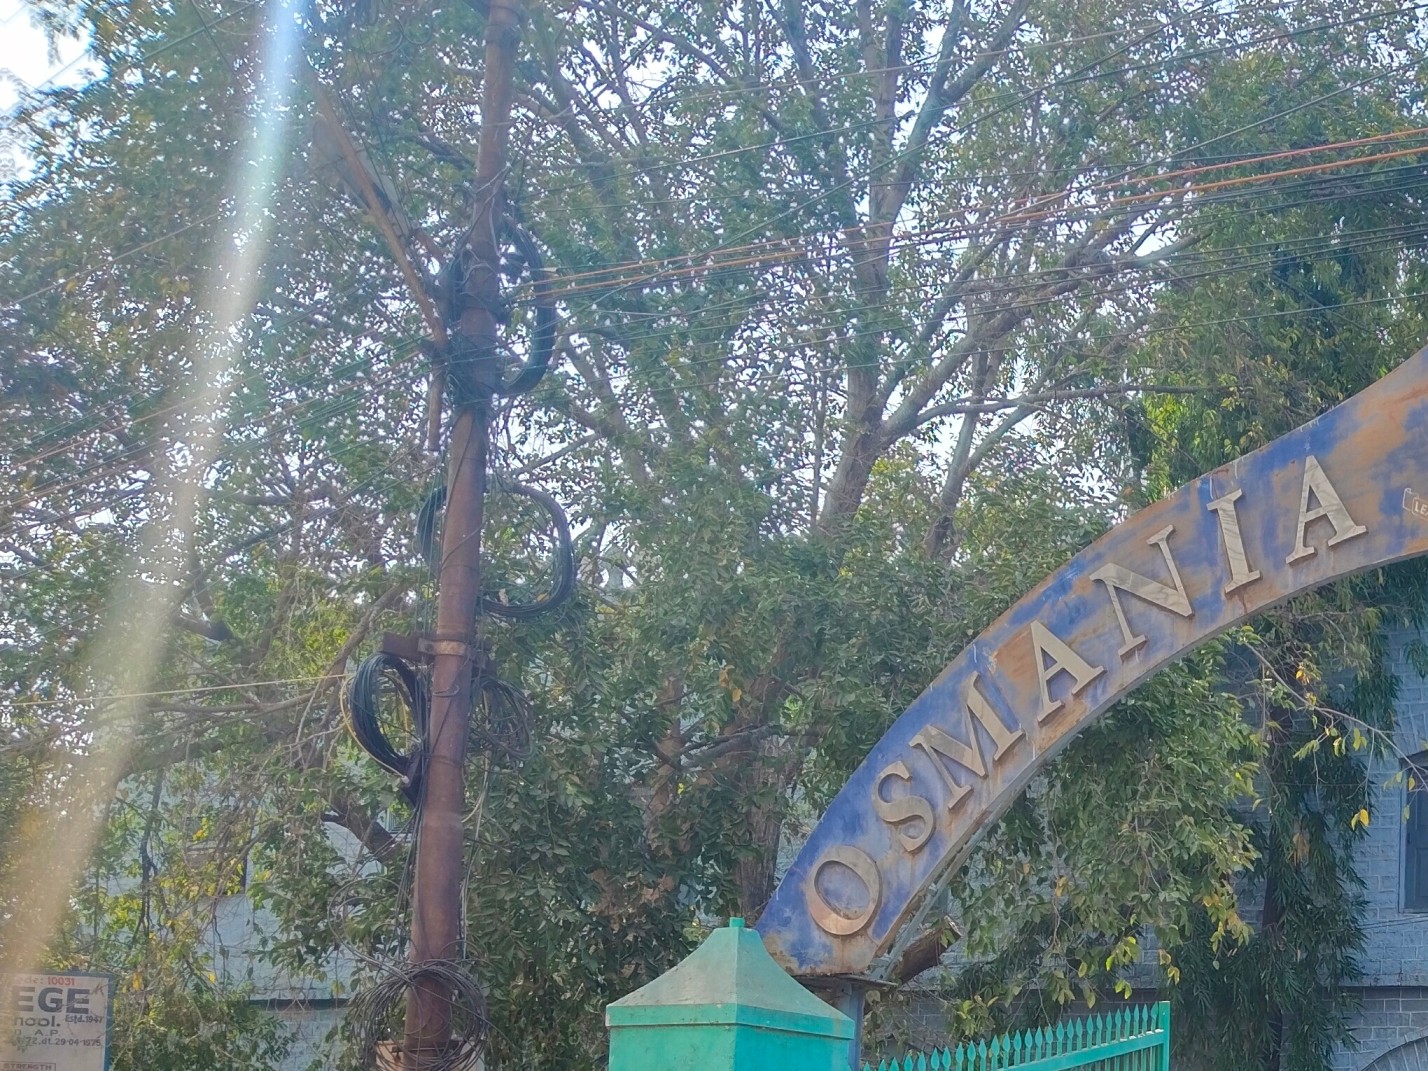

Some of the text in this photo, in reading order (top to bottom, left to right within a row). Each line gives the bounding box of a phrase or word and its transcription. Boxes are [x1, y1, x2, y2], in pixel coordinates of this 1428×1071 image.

[808, 455, 1367, 937] OSMANIA
[48, 976, 75, 986] 10031
[14, 986, 90, 1014] EGE
[14, 1015, 61, 1027] nool.
[3, 1063, 52, 1071] STRENGTH
